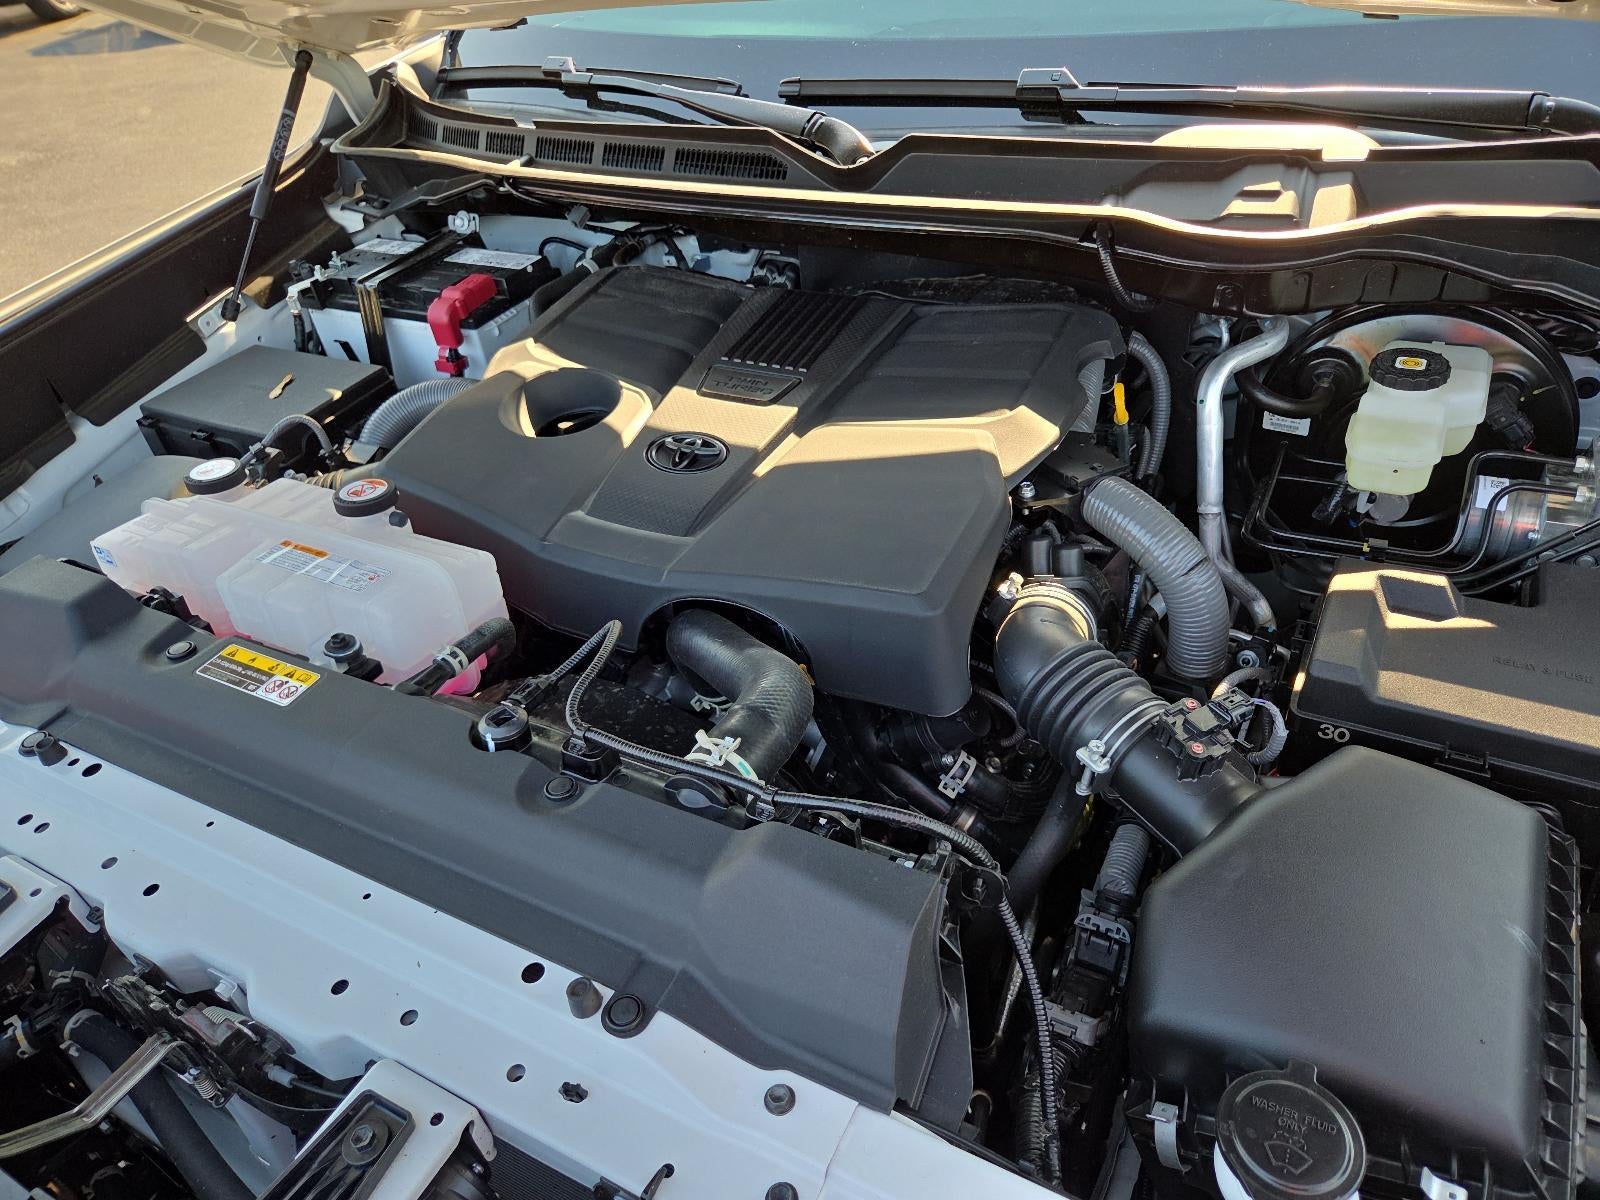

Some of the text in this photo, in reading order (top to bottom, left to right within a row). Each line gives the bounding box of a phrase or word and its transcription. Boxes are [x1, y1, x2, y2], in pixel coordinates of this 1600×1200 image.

[713, 380, 774, 395] TURBO
[1491, 656, 1536, 671] RELAY
[1317, 723, 1351, 743] 30
[1251, 1095, 1337, 1135] WASHER FLUID
[1278, 1117, 1307, 1134] ONLY
